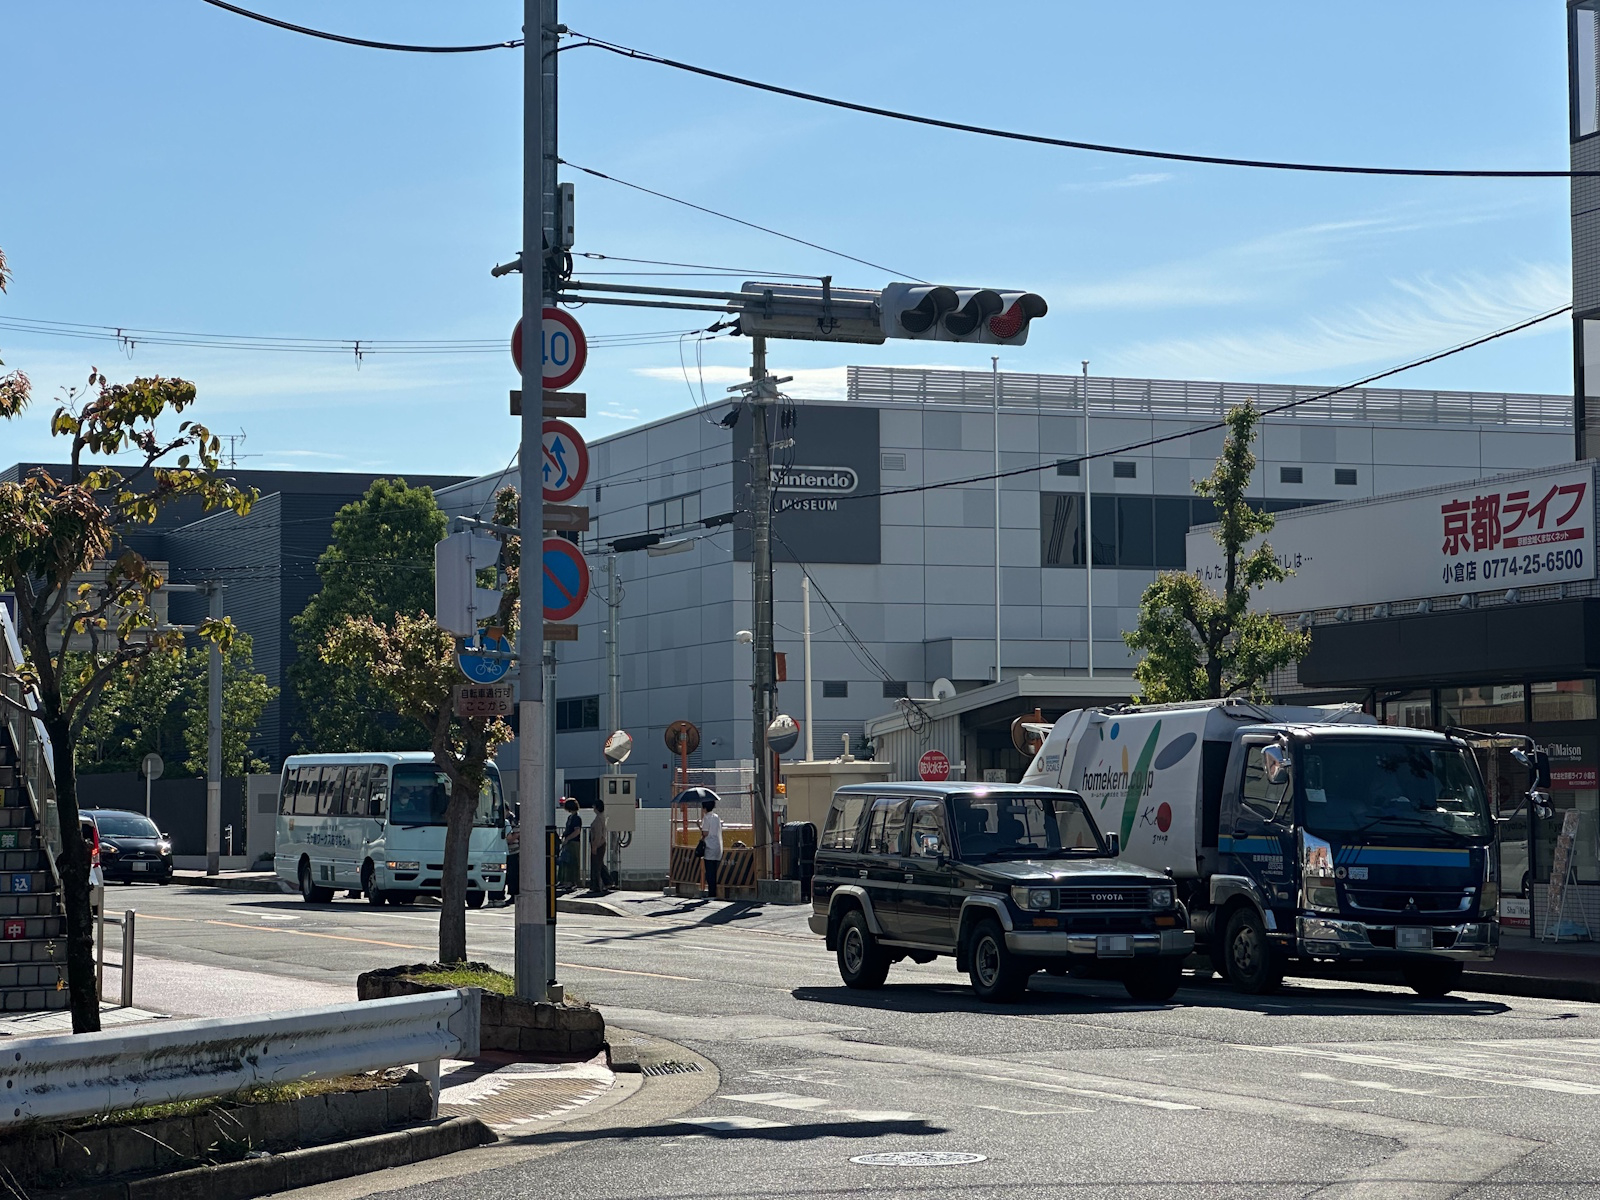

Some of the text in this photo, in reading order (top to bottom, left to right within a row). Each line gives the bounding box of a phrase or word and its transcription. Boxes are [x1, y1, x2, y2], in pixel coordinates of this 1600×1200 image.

[770, 471, 849, 487] Nintendo
[782, 499, 837, 511] MUSEUM
[1441, 482, 1587, 556] 京都ライフ
[1442, 548, 1583, 584] 小倉店 0774-25-6500
[462, 687, 511, 699] 自転車通行可
[467, 701, 507, 711] ここから
[921, 761, 949, 774] 防火水そう
[1082, 765, 1154, 797] homekern.co.jp
[1, 834, 15, 848] 策
[15, 878, 28, 892] 込
[8, 924, 22, 938] 中
